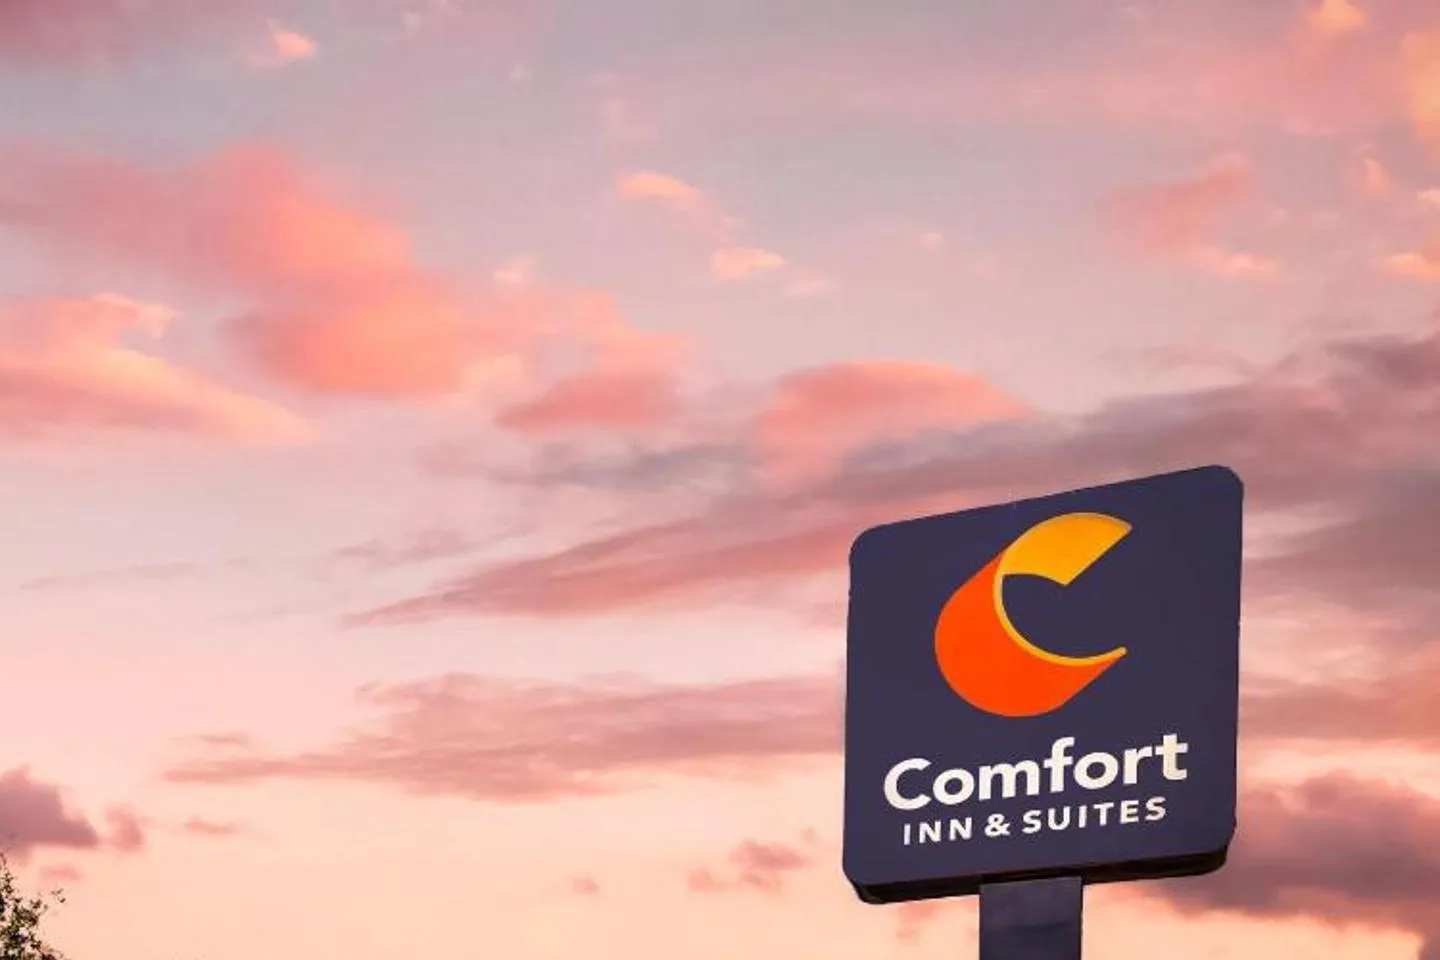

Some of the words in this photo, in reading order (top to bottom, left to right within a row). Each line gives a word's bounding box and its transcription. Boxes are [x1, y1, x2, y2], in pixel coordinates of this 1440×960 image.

[883, 733, 1189, 811] Comfort
[903, 816, 973, 846] INN
[984, 813, 1011, 838] &
[1022, 796, 1167, 834] SUITES
